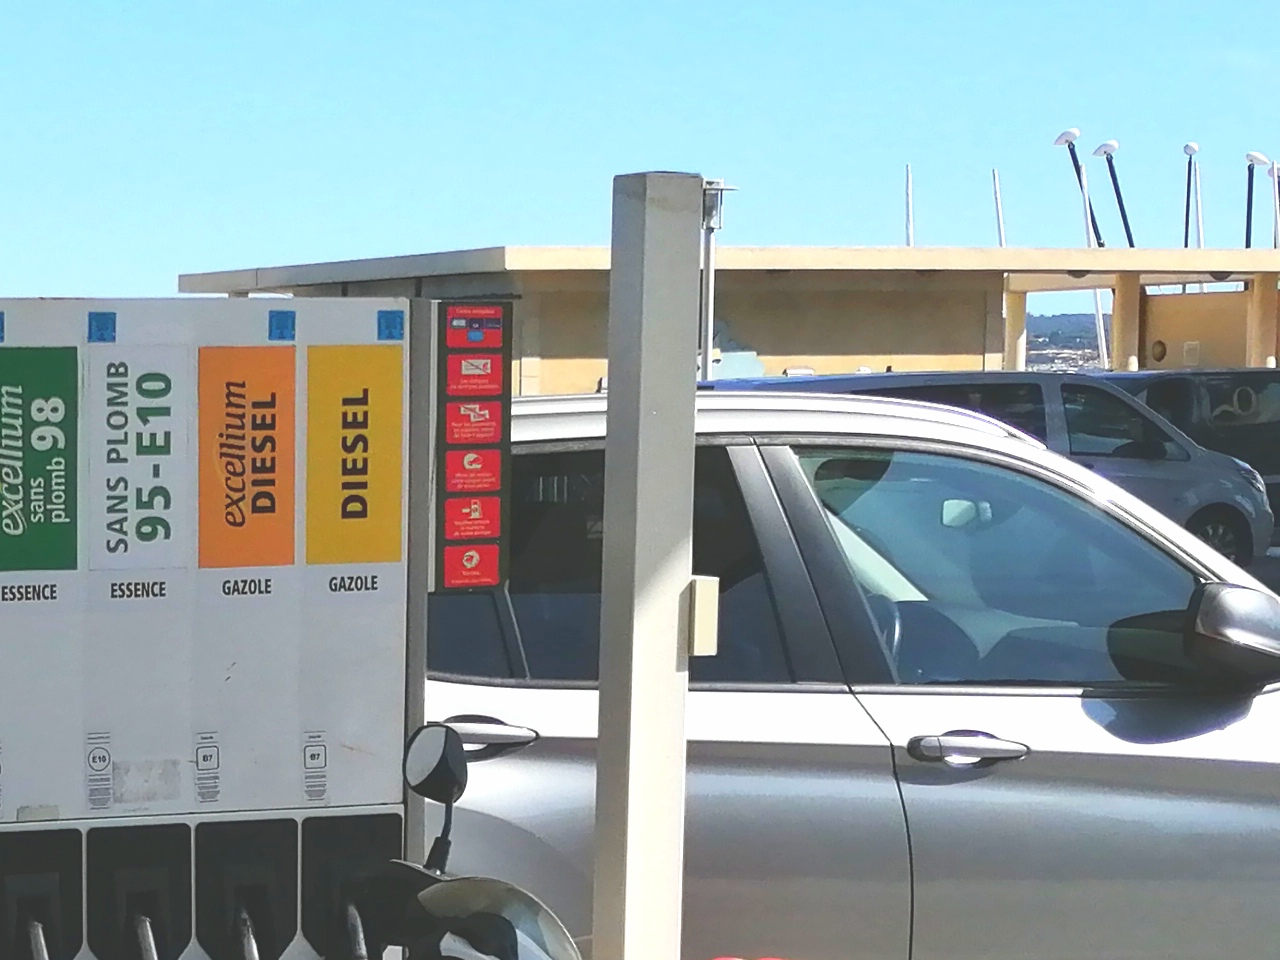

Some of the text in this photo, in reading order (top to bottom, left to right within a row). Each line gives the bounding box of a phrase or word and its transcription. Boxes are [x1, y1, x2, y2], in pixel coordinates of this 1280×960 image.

[30, 397, 70, 523] plomb 98
[106, 361, 129, 553] SANS PLOMB
[135, 372, 172, 542] 95-E10
[218, 380, 246, 528] excellium
[251, 392, 276, 514] DIESEL
[341, 388, 369, 520] DIESEL
[30, 477, 44, 523] sans
[0, 584, 58, 602] ESSENCE
[110, 581, 166, 599] ESSENCE
[222, 579, 272, 595] GAZOLE
[329, 575, 378, 592] GAZOLE
[91, 755, 107, 764] E10
